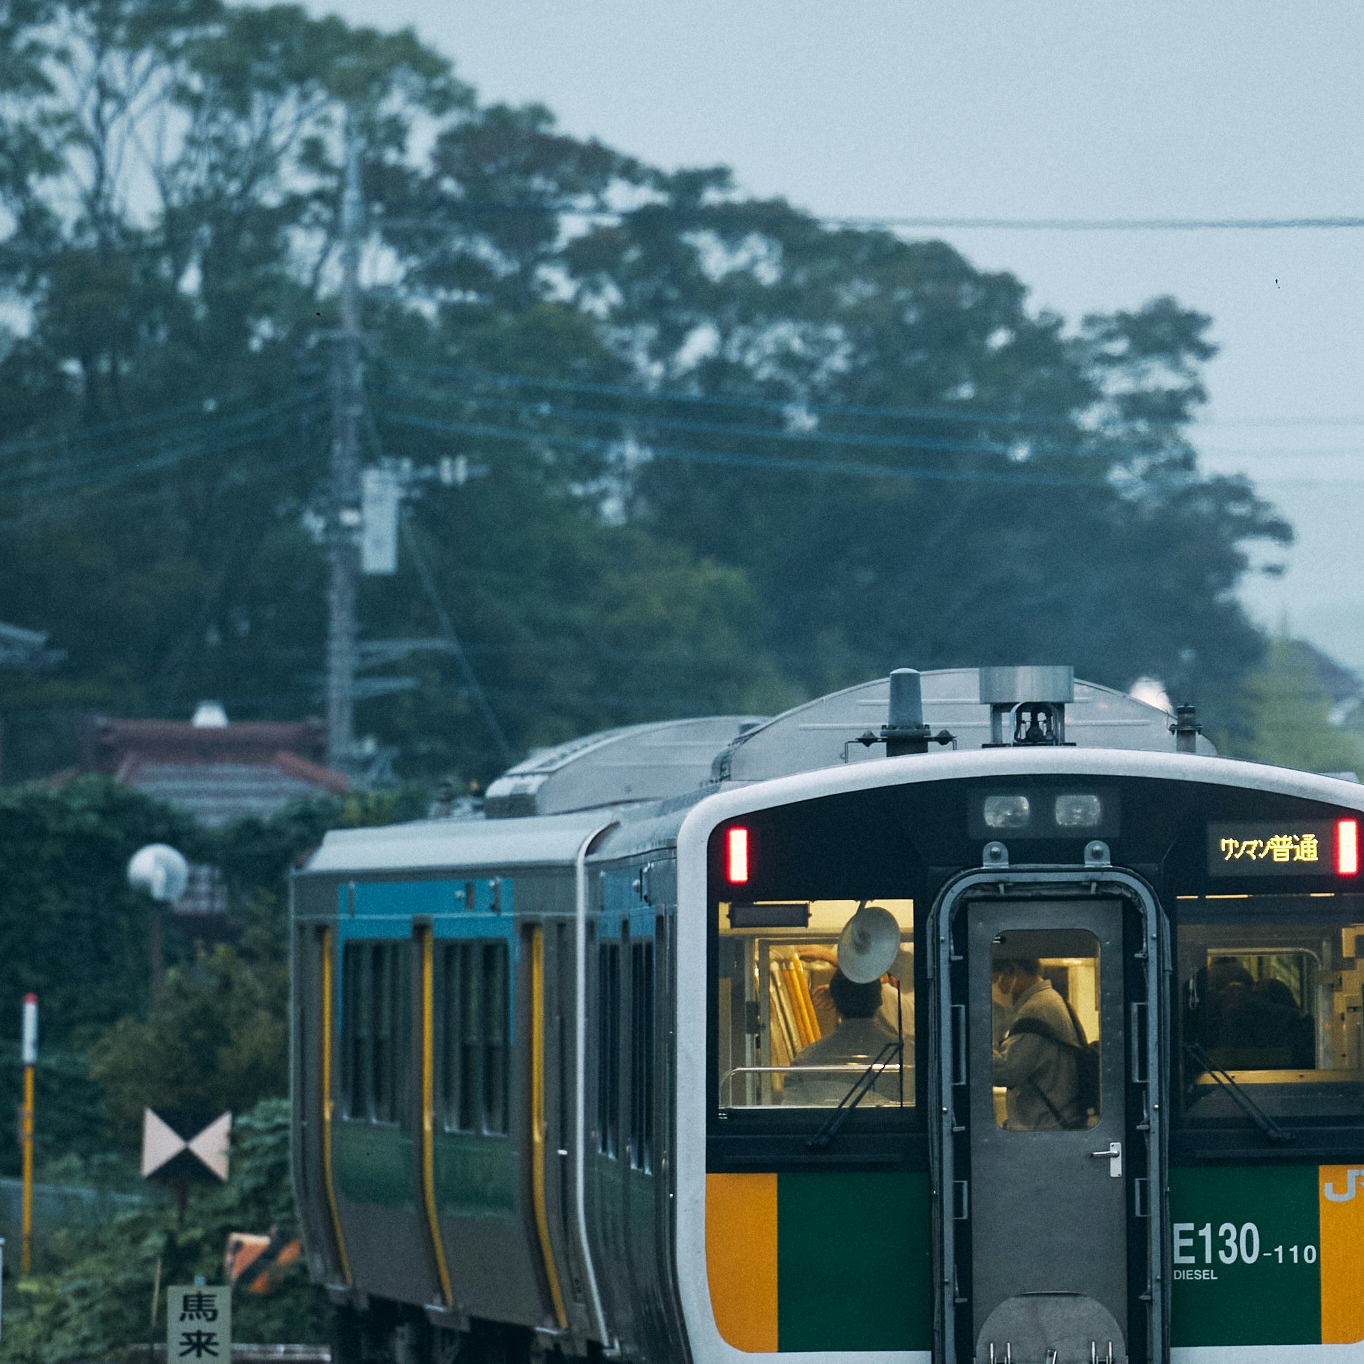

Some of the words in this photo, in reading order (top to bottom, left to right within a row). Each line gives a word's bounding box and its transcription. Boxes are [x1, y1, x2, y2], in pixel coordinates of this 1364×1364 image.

[1220, 833, 1319, 862] ワンマン普通
[1173, 1269, 1218, 1280] DIESEL
